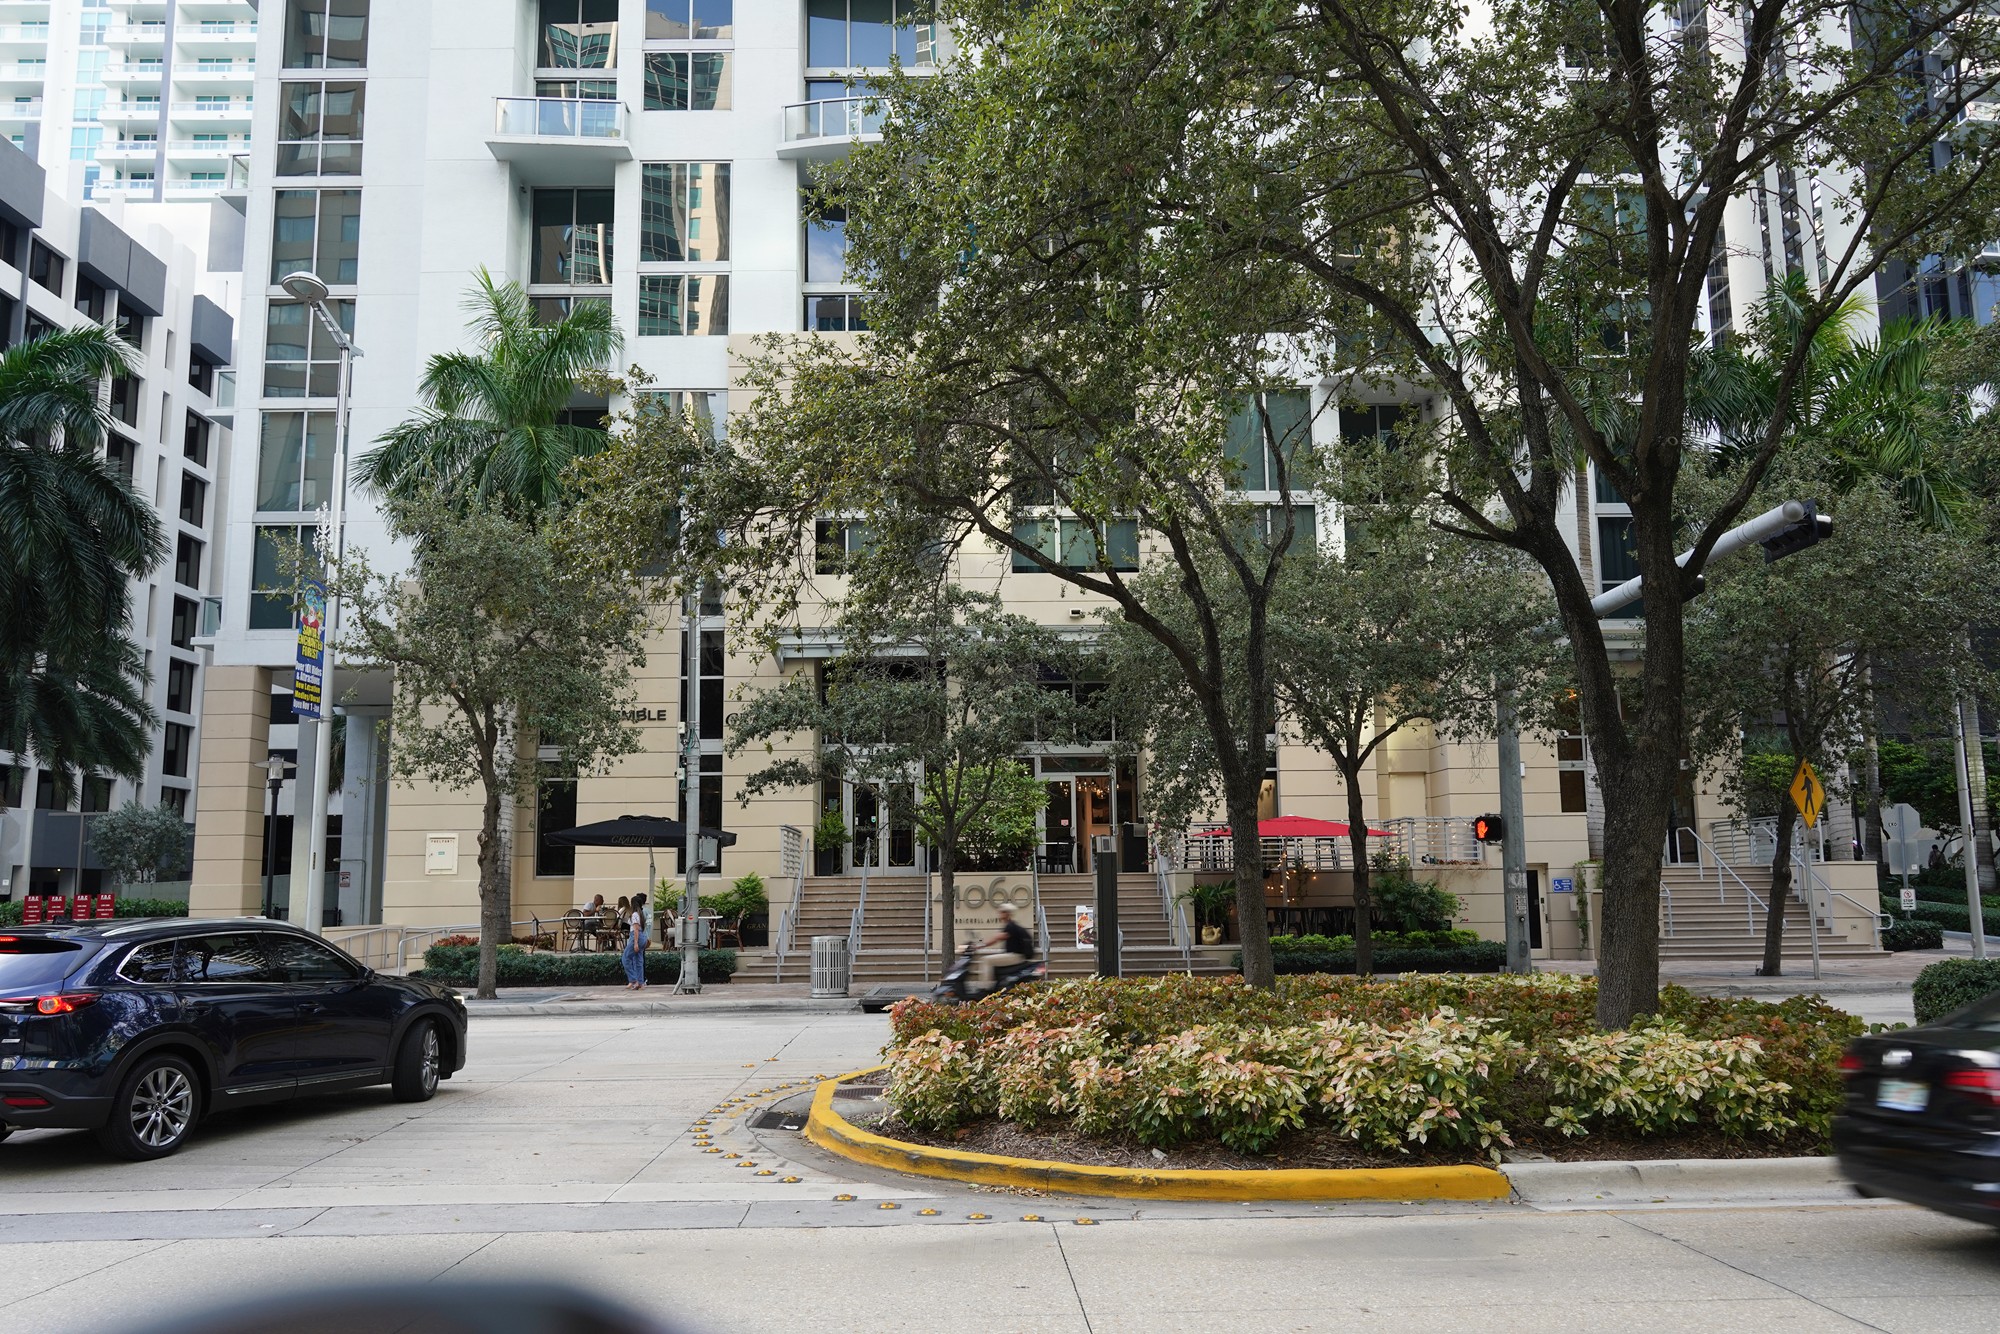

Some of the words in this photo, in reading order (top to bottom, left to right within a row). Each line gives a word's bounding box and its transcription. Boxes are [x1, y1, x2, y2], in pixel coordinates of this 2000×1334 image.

[298, 634, 323, 651] ENCHANTED
[302, 645, 318, 659] FOREST
[312, 665, 322, 677] Rides
[296, 680, 305, 689] New
[305, 682, 320, 693] Location
